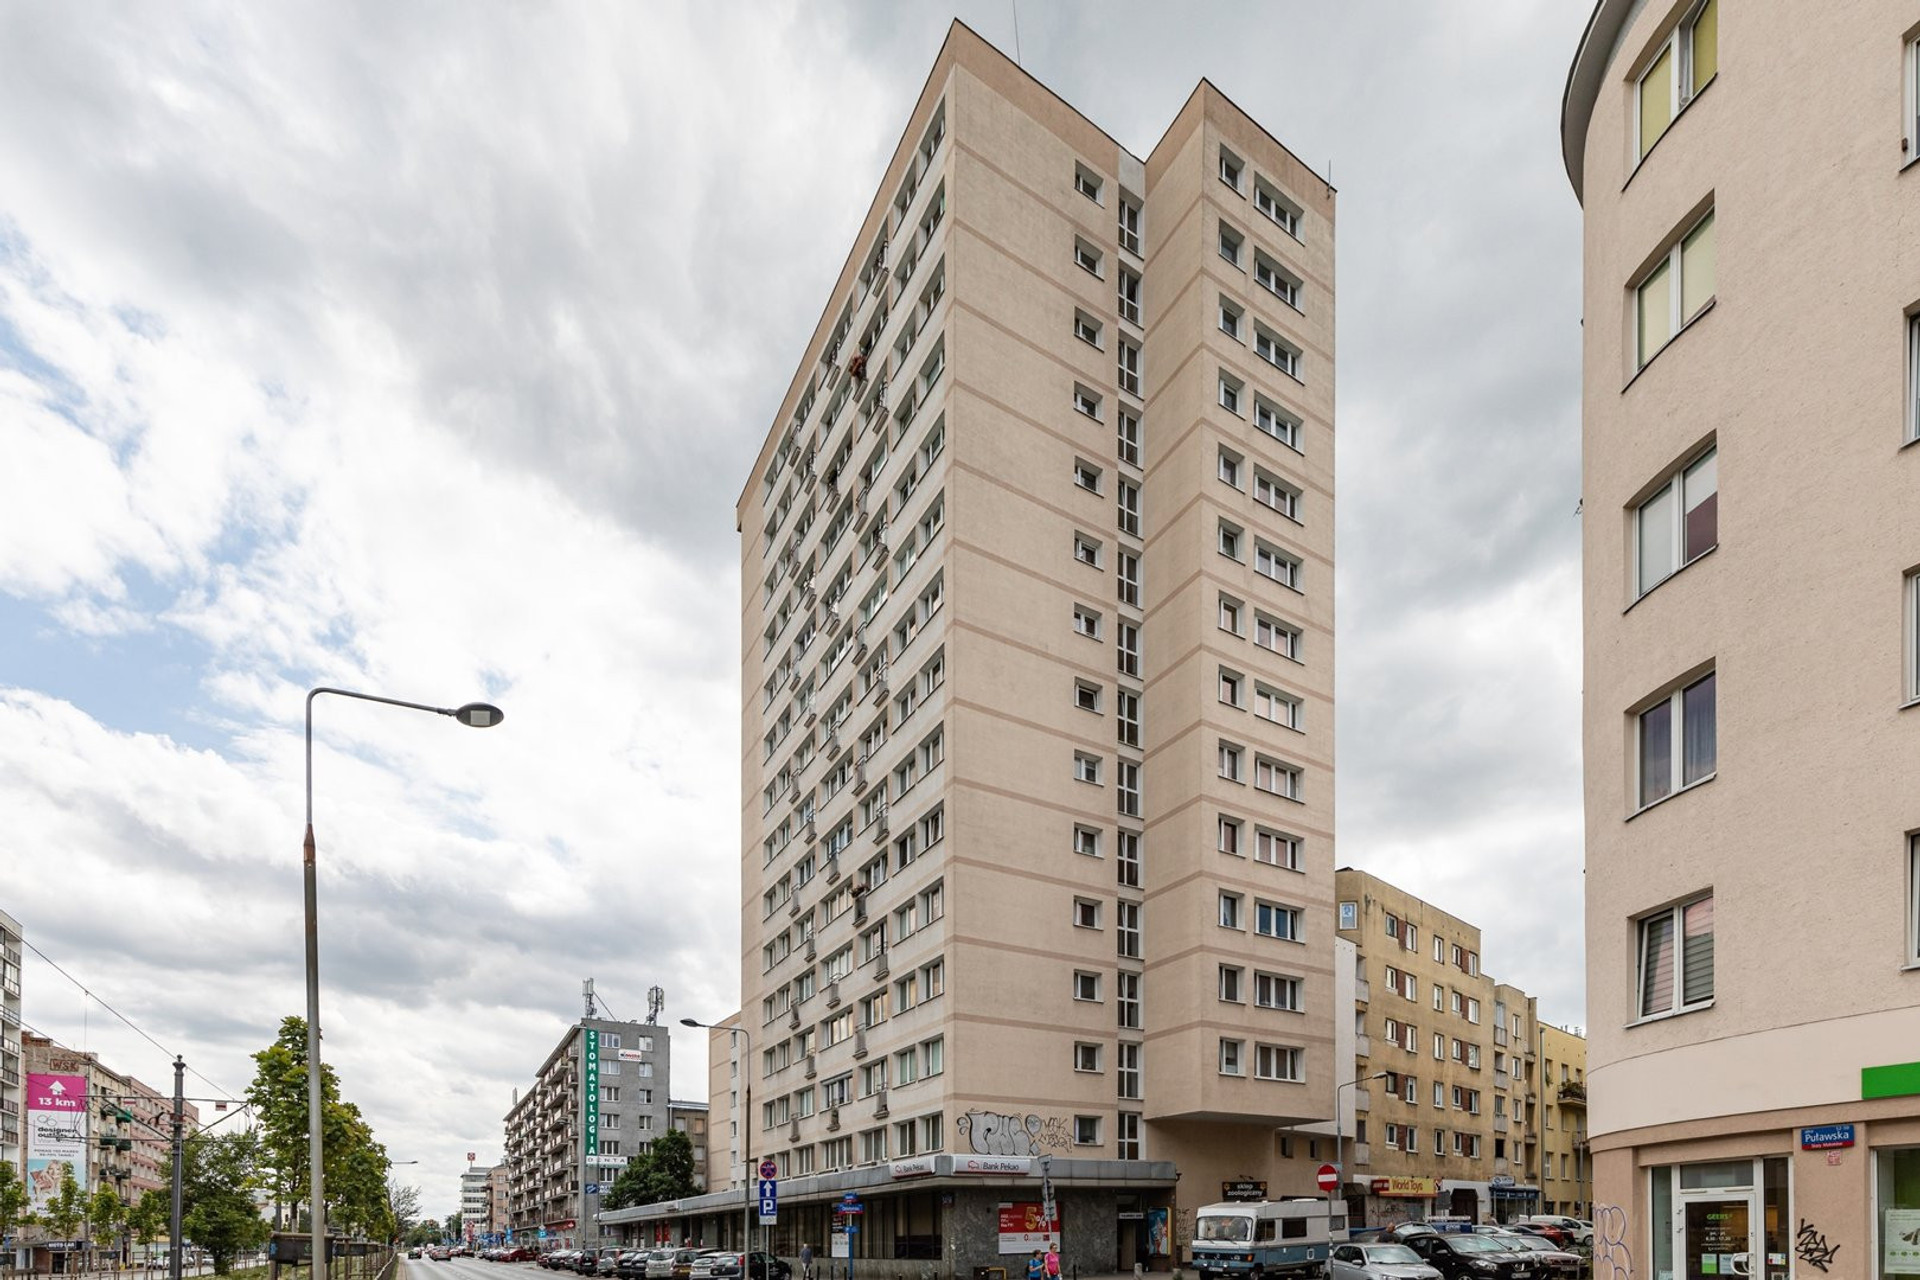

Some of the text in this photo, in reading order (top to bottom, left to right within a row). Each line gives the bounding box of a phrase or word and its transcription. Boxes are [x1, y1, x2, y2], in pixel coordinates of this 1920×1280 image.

[588, 1031, 596, 1154] STOMATOLOGIA
[55, 1098, 76, 1106] km
[1804, 1131, 1849, 1142] Puławska
[912, 1163, 925, 1171] Pekao
[983, 1162, 1020, 1171] Bank Pekao
[1237, 1183, 1253, 1191] sklep
[1392, 1179, 1410, 1190] World
[1410, 1180, 1423, 1193] Toys
[763, 1200, 773, 1214] P
